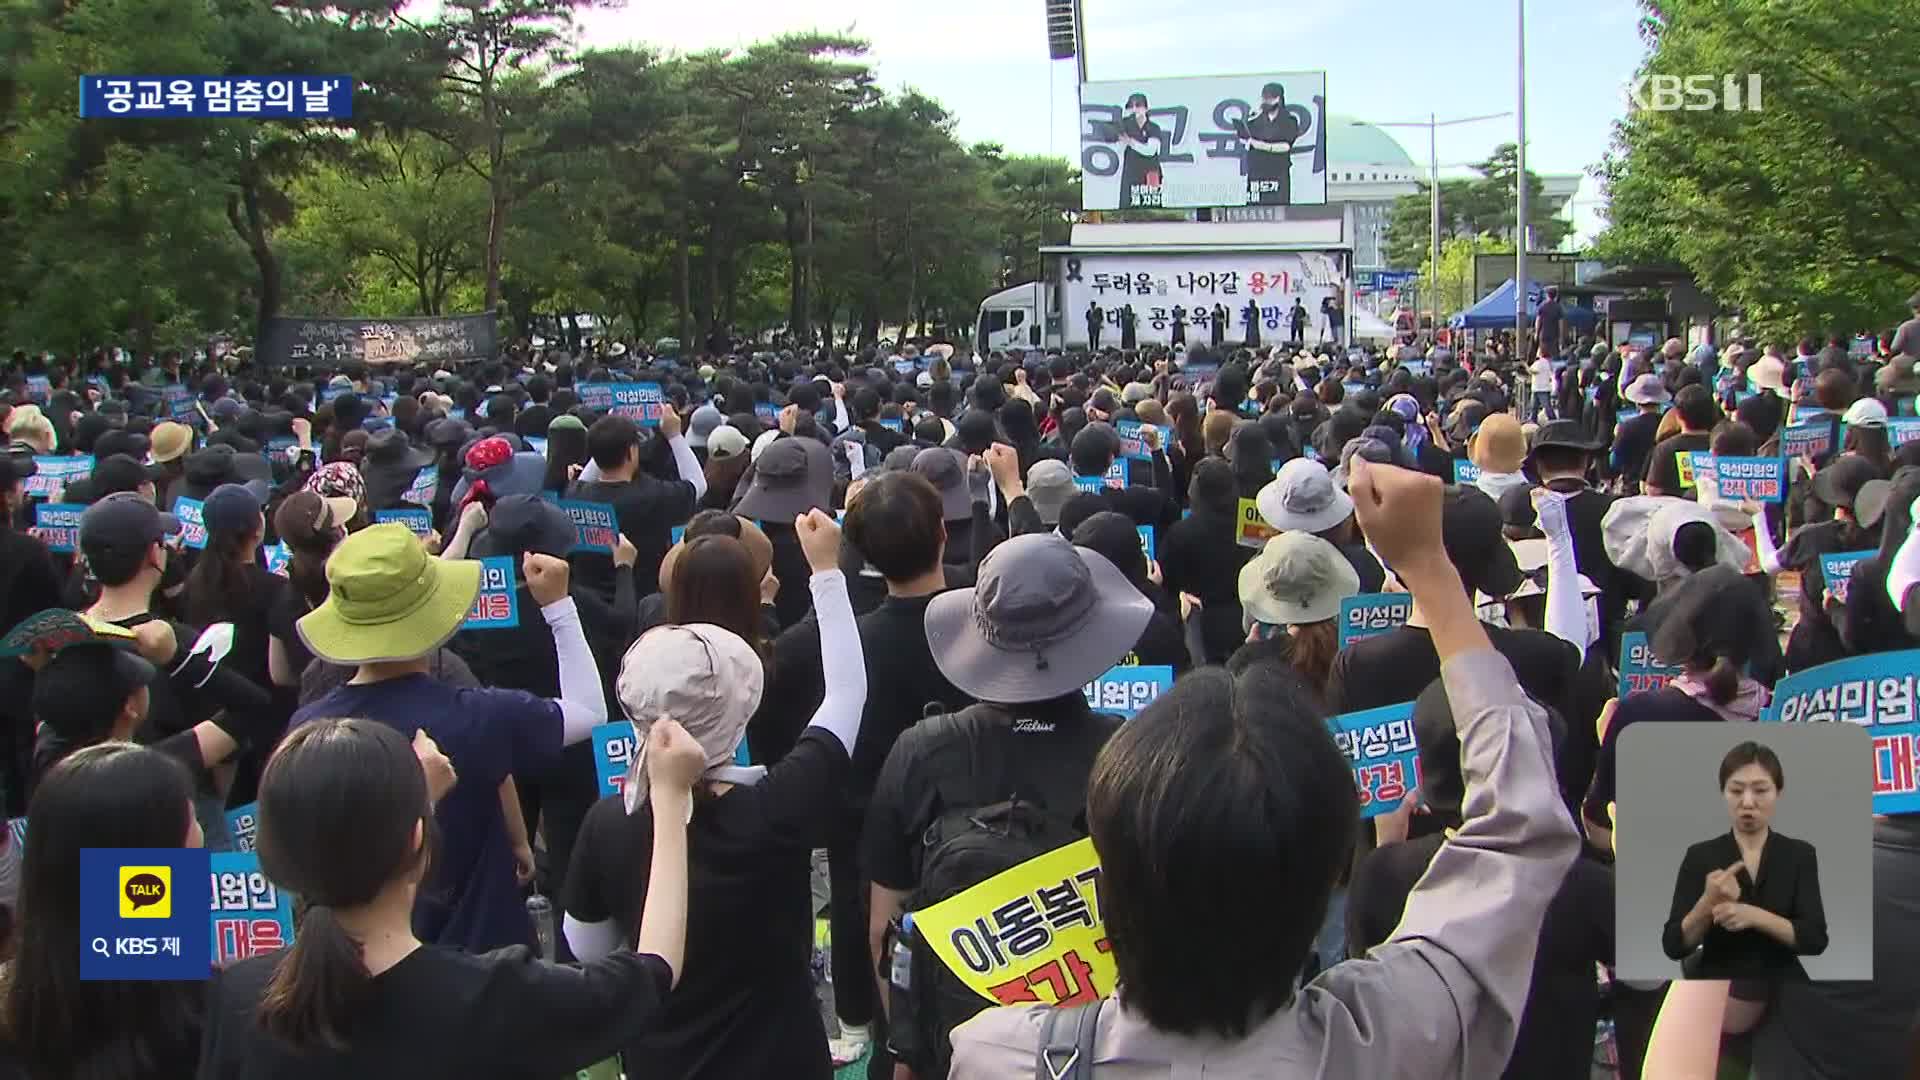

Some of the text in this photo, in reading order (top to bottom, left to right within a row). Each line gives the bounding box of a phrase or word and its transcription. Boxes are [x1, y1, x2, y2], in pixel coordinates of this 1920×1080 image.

[1091, 272, 1168, 296] 두려움을
[1177, 271, 1240, 296] 나아갈
[1148, 305, 1230, 330] 공육
[563, 507, 611, 527] 민원인
[1873, 734, 1920, 796] 대
